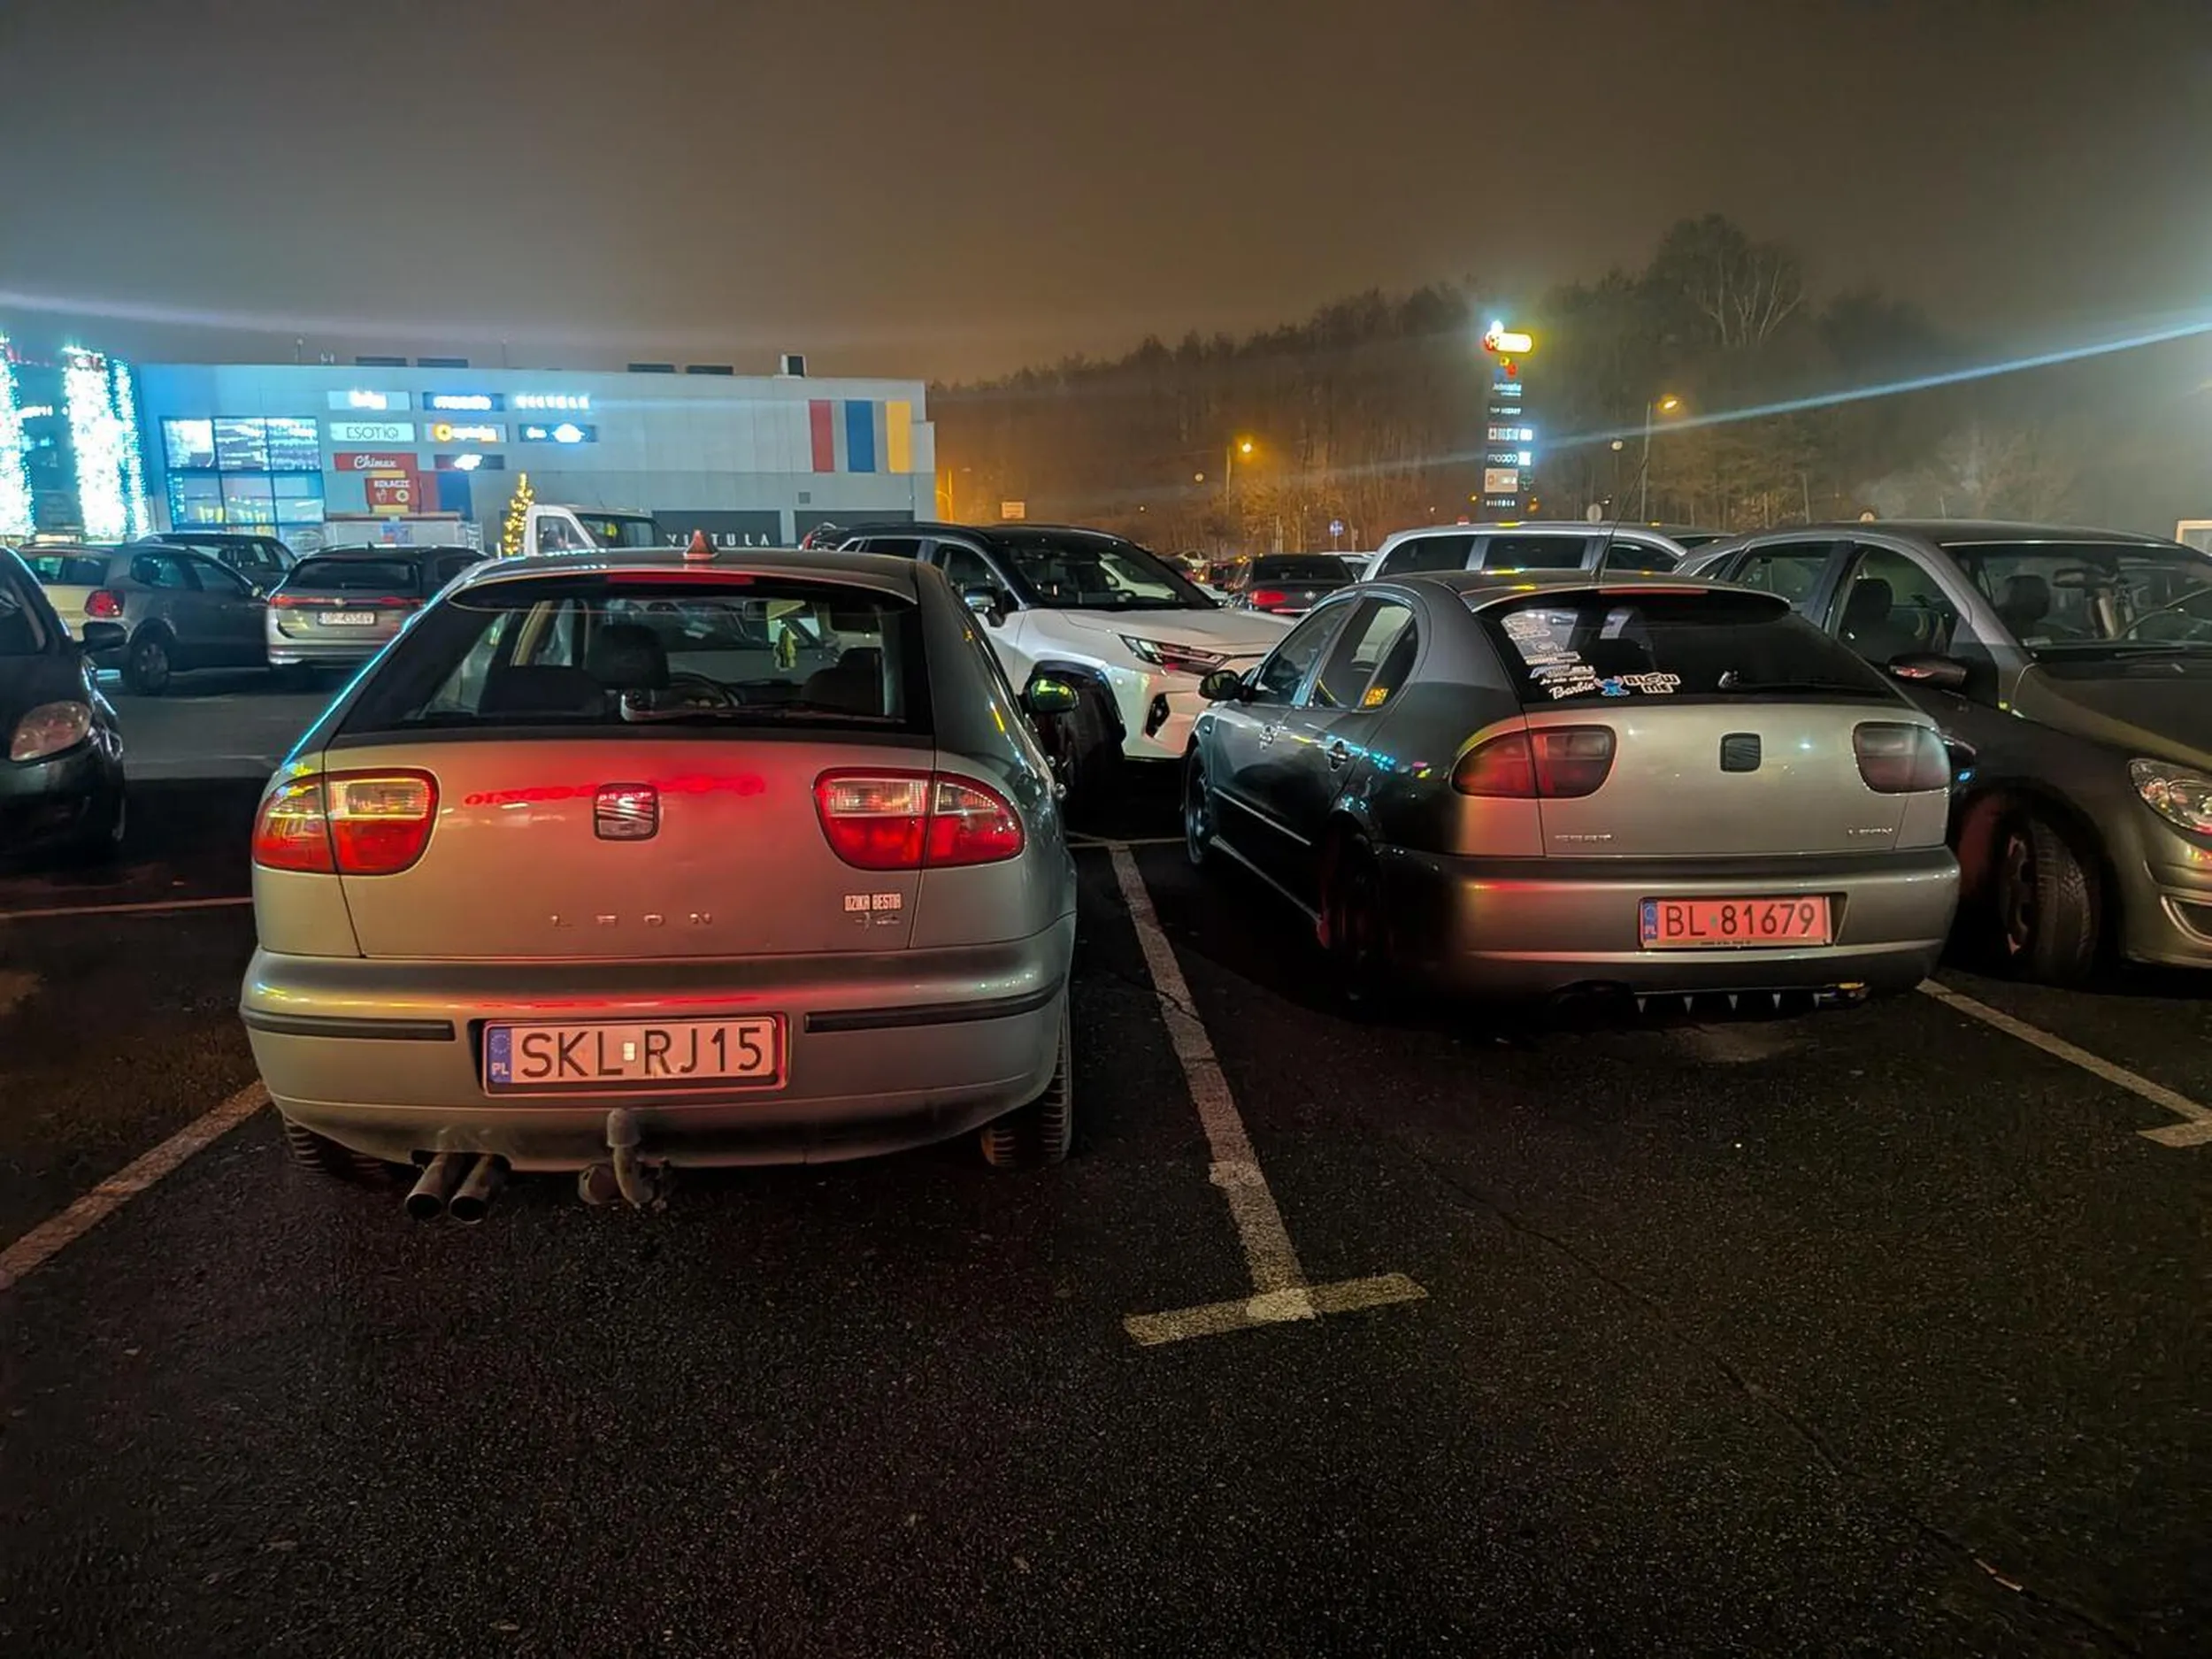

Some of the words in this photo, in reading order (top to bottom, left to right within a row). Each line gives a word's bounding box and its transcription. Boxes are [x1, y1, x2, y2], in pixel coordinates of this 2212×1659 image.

[346, 426, 399, 440] ESOTIQ
[665, 533, 770, 548] VITULA
[1548, 682, 1595, 700] Barbie
[1665, 905, 1706, 937] BL
[1720, 902, 1815, 935] 81679
[520, 1030, 624, 1079] SKL
[644, 1026, 763, 1076] RJ15
[491, 1062, 510, 1076] PL
